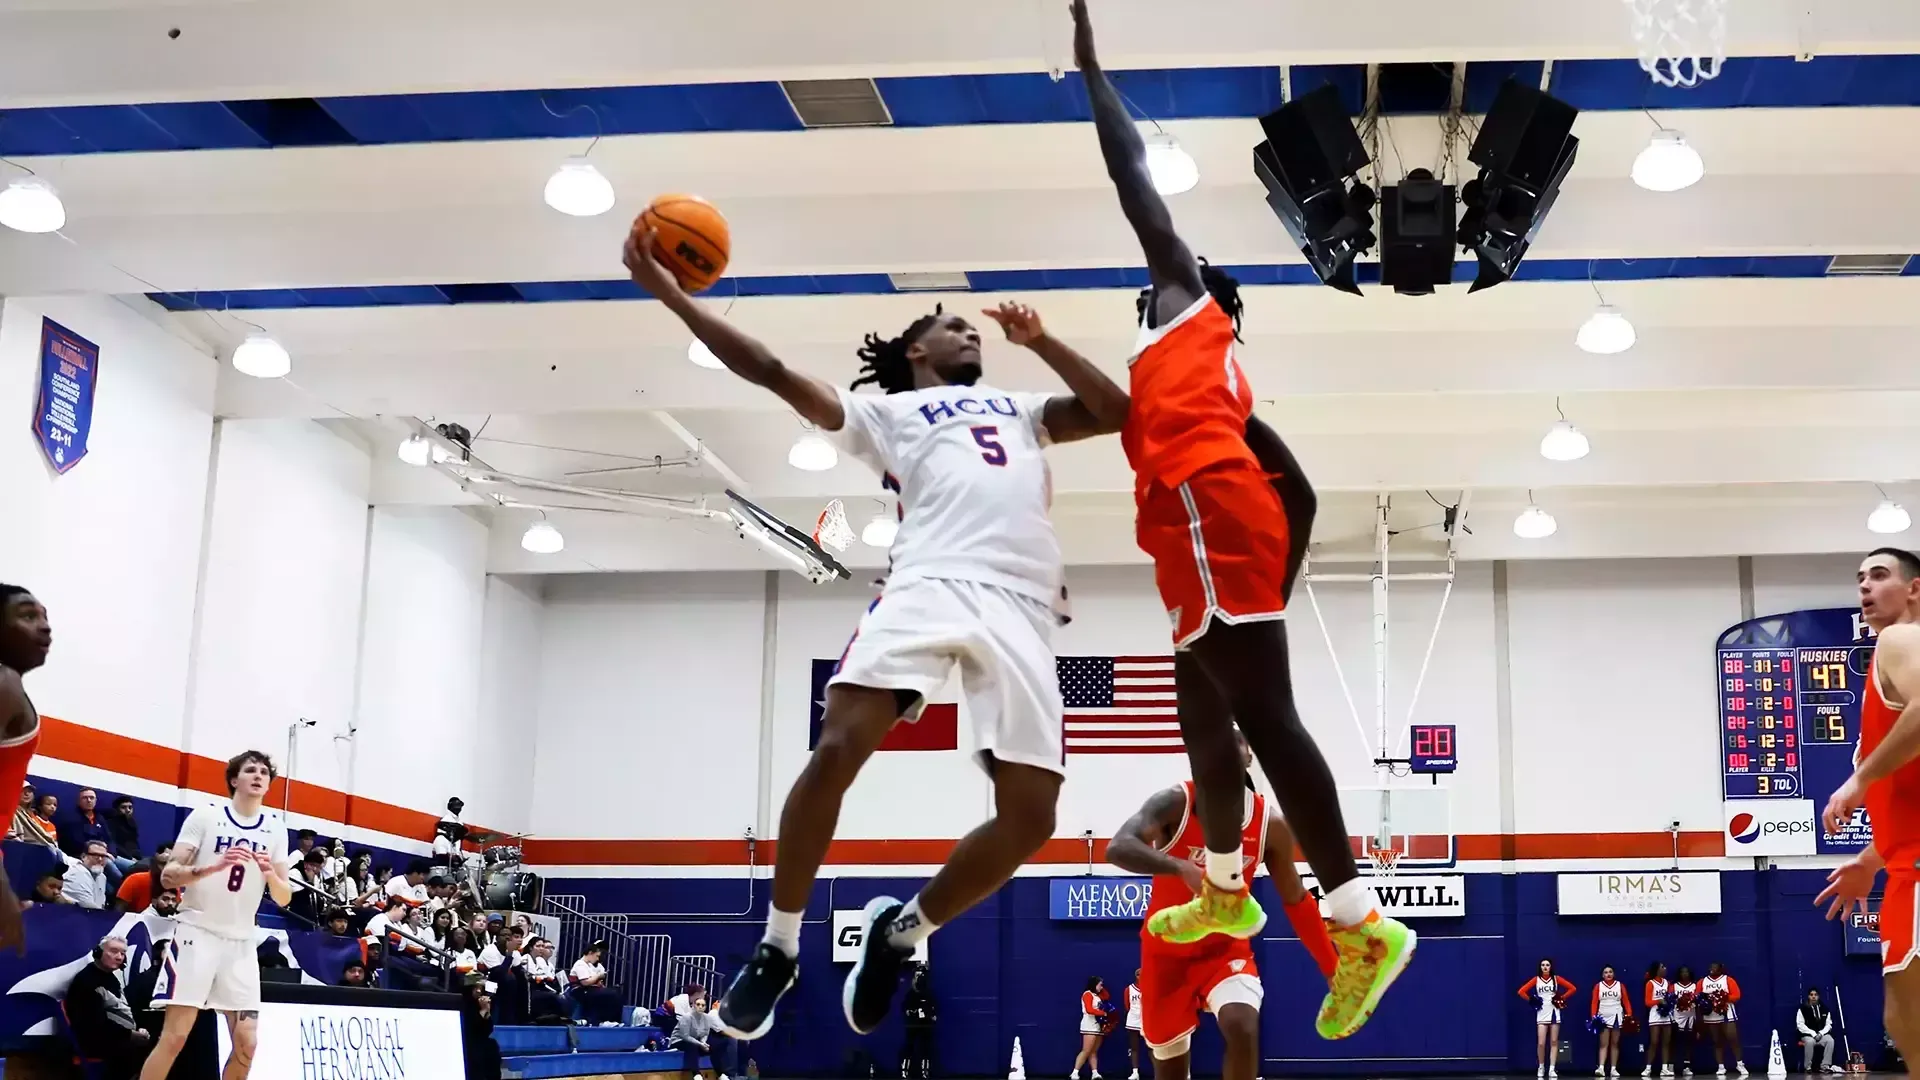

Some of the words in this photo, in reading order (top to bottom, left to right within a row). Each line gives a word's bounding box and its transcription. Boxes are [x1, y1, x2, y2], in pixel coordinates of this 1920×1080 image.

[919, 397, 1017, 426] HCU
[50, 427, 72, 447] 23-11
[970, 426, 1008, 467] 5
[1800, 650, 1848, 663] HUSKIES
[1762, 677, 1773, 692] 0
[1812, 664, 1846, 689] 47
[1763, 696, 1773, 711] 2
[1817, 706, 1841, 715] FOULS
[1764, 715, 1775, 730] 0
[1828, 715, 1845, 741] 5
[1415, 728, 1451, 756] 20
[1761, 734, 1776, 749] 12
[1766, 752, 1777, 767] 2
[1757, 776, 1769, 794] 3
[1773, 779, 1792, 790] TOL
[1763, 818, 1814, 836] pepsi
[227, 864, 245, 892] 8
[1599, 874, 1682, 894] IRMA'S
[1375, 886, 1459, 906] WILL.
[1539, 985, 1554, 993] HCU
[300, 1017, 404, 1050] MEMORIAL
[1773, 1040, 1782, 1065] HCU
[301, 1048, 404, 1080] HERMANN
